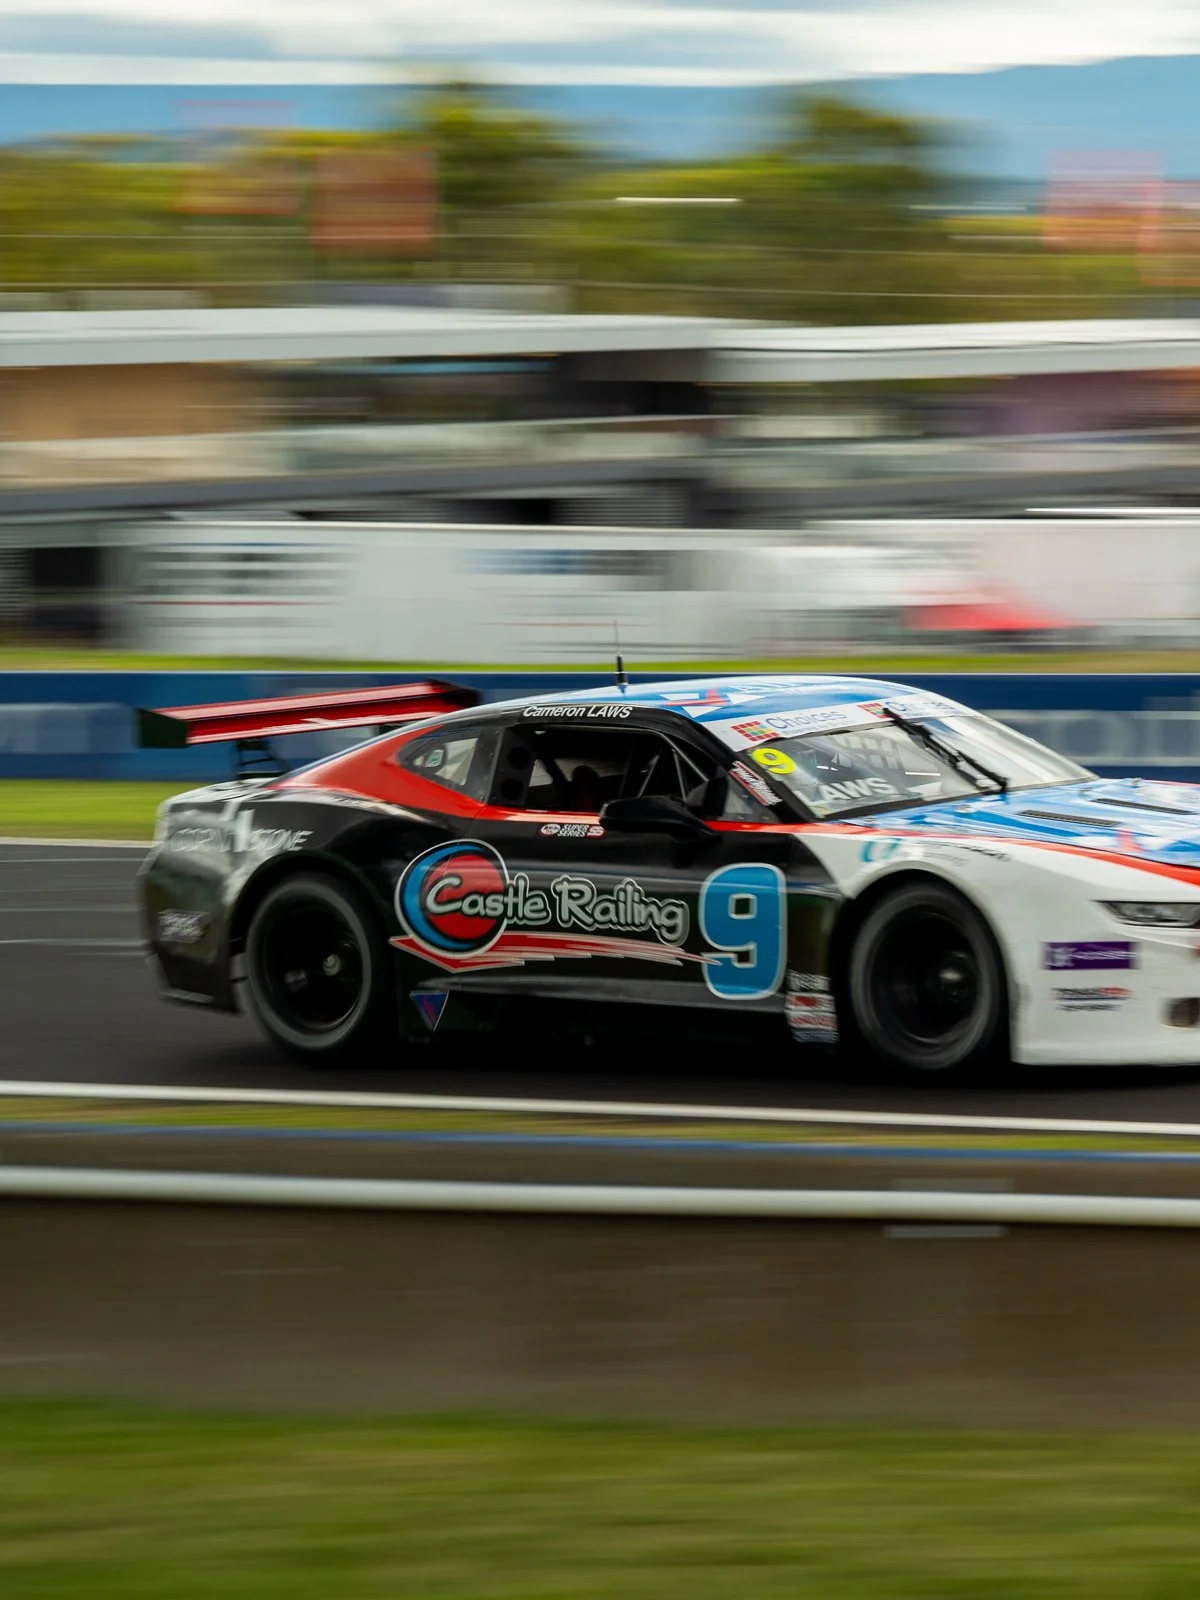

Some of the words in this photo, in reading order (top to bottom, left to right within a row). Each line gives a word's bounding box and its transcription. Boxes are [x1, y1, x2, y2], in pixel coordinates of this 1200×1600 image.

[523, 705, 587, 718] Cameron
[587, 705, 633, 718] LAWS
[766, 711, 847, 729] Choices
[751, 747, 796, 775] 9
[557, 830, 585, 838] SERIES
[561, 824, 590, 832] SUPER
[425, 873, 551, 925] Castle
[551, 873, 690, 947] Railing
[699, 862, 788, 1000] 9
